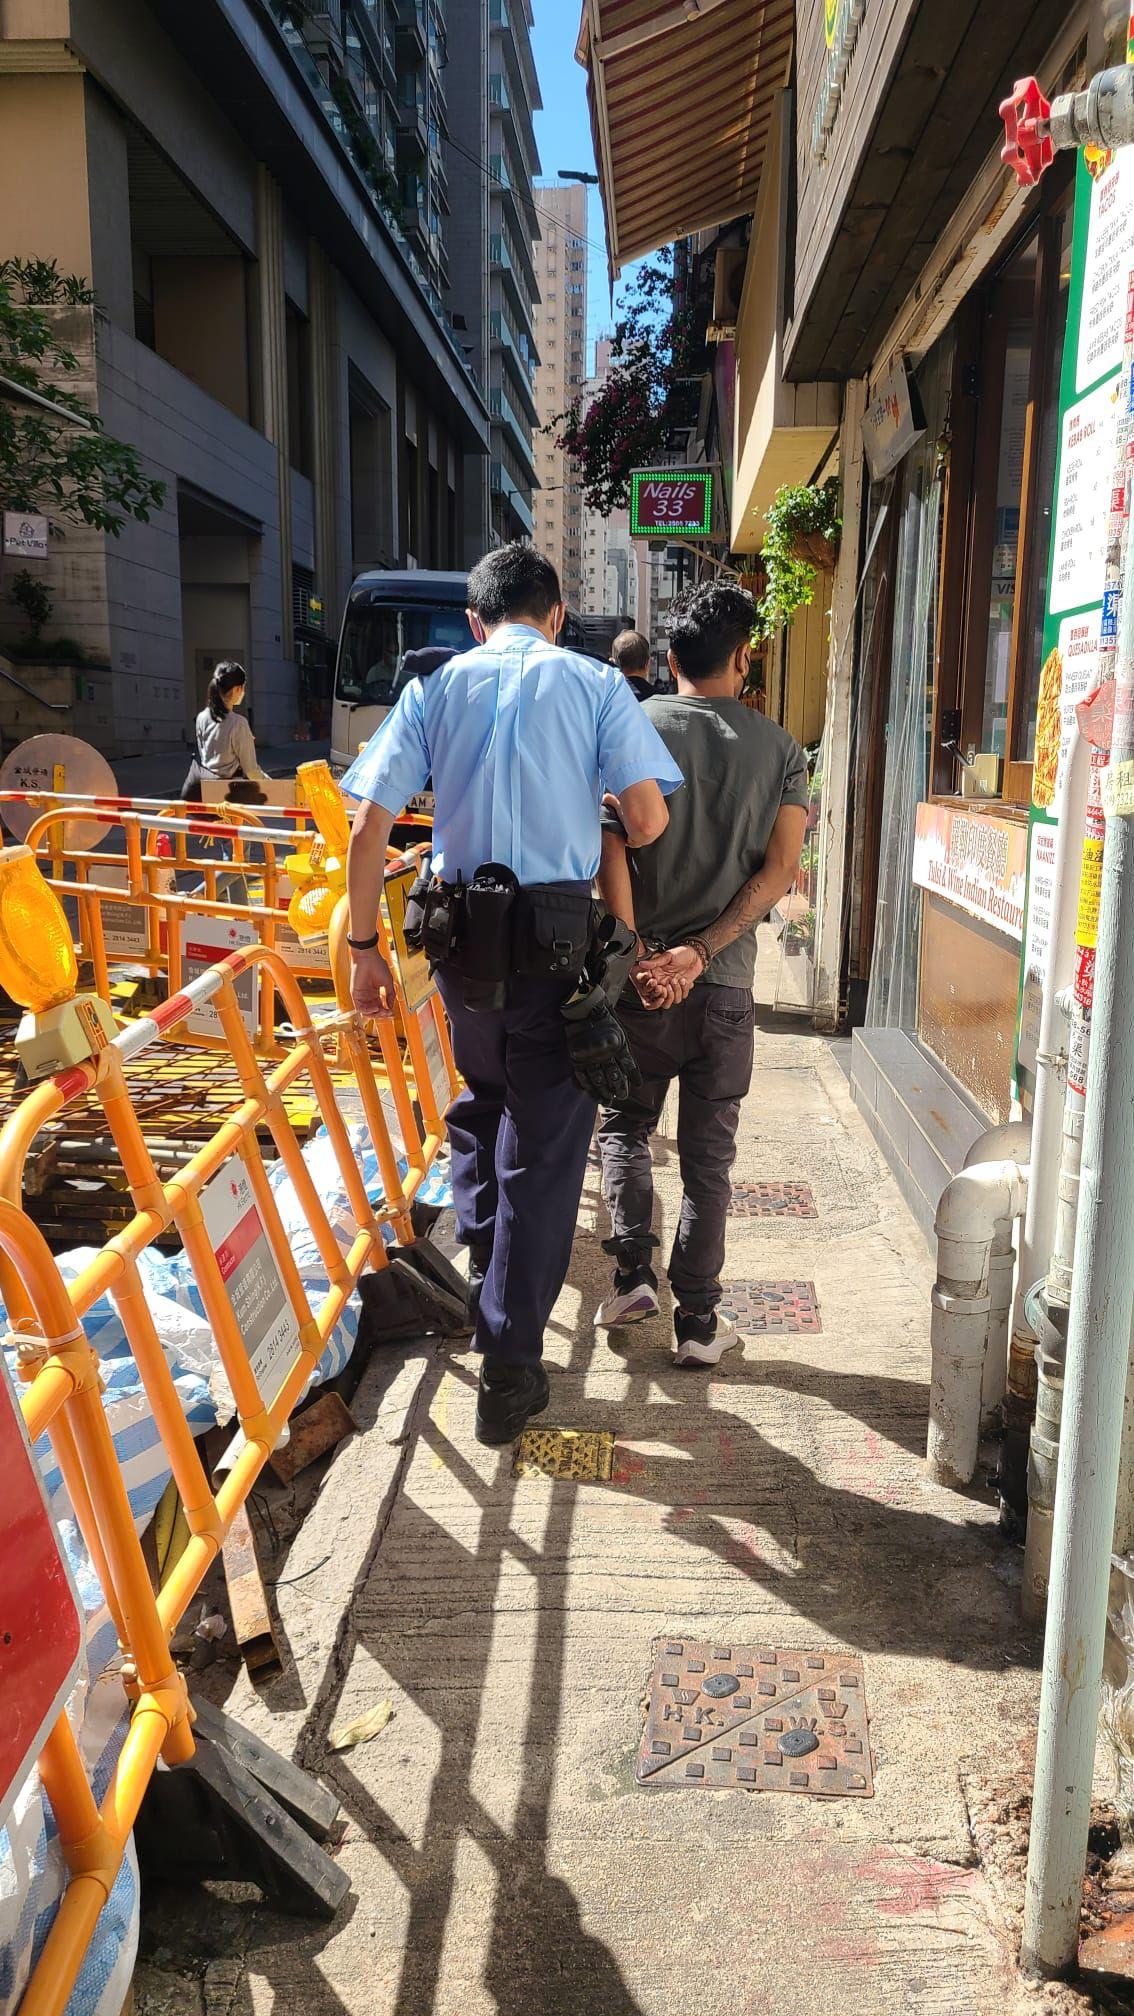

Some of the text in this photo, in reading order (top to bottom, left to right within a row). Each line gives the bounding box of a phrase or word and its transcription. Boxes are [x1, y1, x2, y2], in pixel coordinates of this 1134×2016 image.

[643, 482, 696, 499] Nails
[653, 500, 683, 516] 33
[997, 583, 1016, 594] VIS
[410, 796, 426, 807] AM
[963, 875, 987, 909] Indian
[209, 1010, 218, 1018] 28
[266, 1318, 291, 1360] 2814 3443
